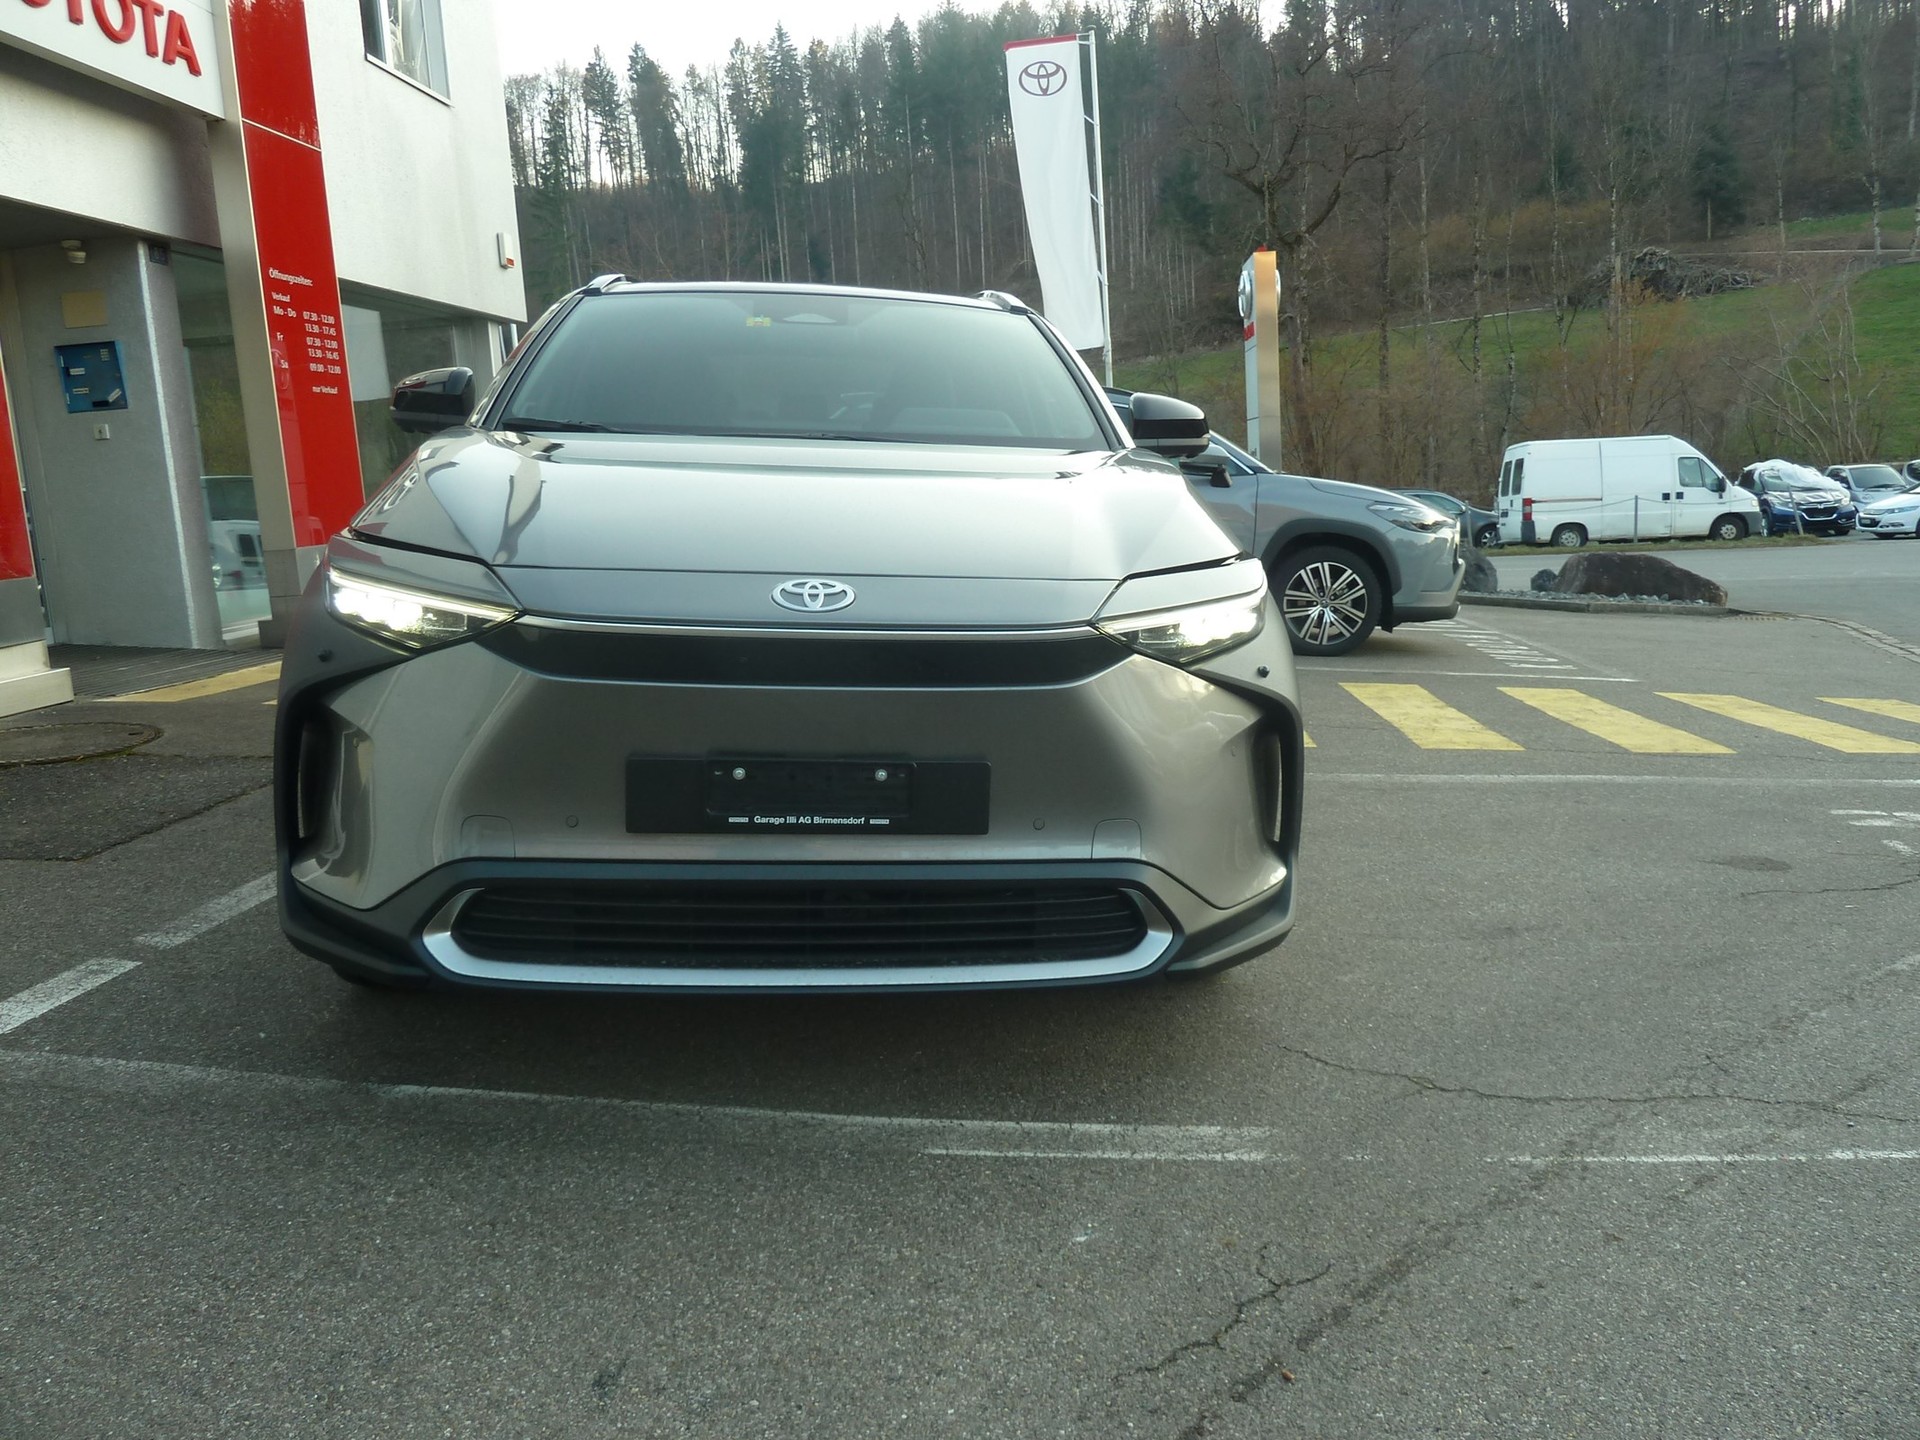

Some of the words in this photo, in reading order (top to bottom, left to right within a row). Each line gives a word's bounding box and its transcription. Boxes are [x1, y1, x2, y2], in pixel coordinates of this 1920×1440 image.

[273, 305, 284, 316] Mo
[287, 308, 297, 317] Do
[303, 311, 318, 321] 07.30
[276, 332, 284, 341] Fr
[280, 359, 289, 369] Sa
[754, 815, 785, 825] Garage
[798, 816, 812, 824] AG
[813, 816, 865, 825] Birmensdorf
